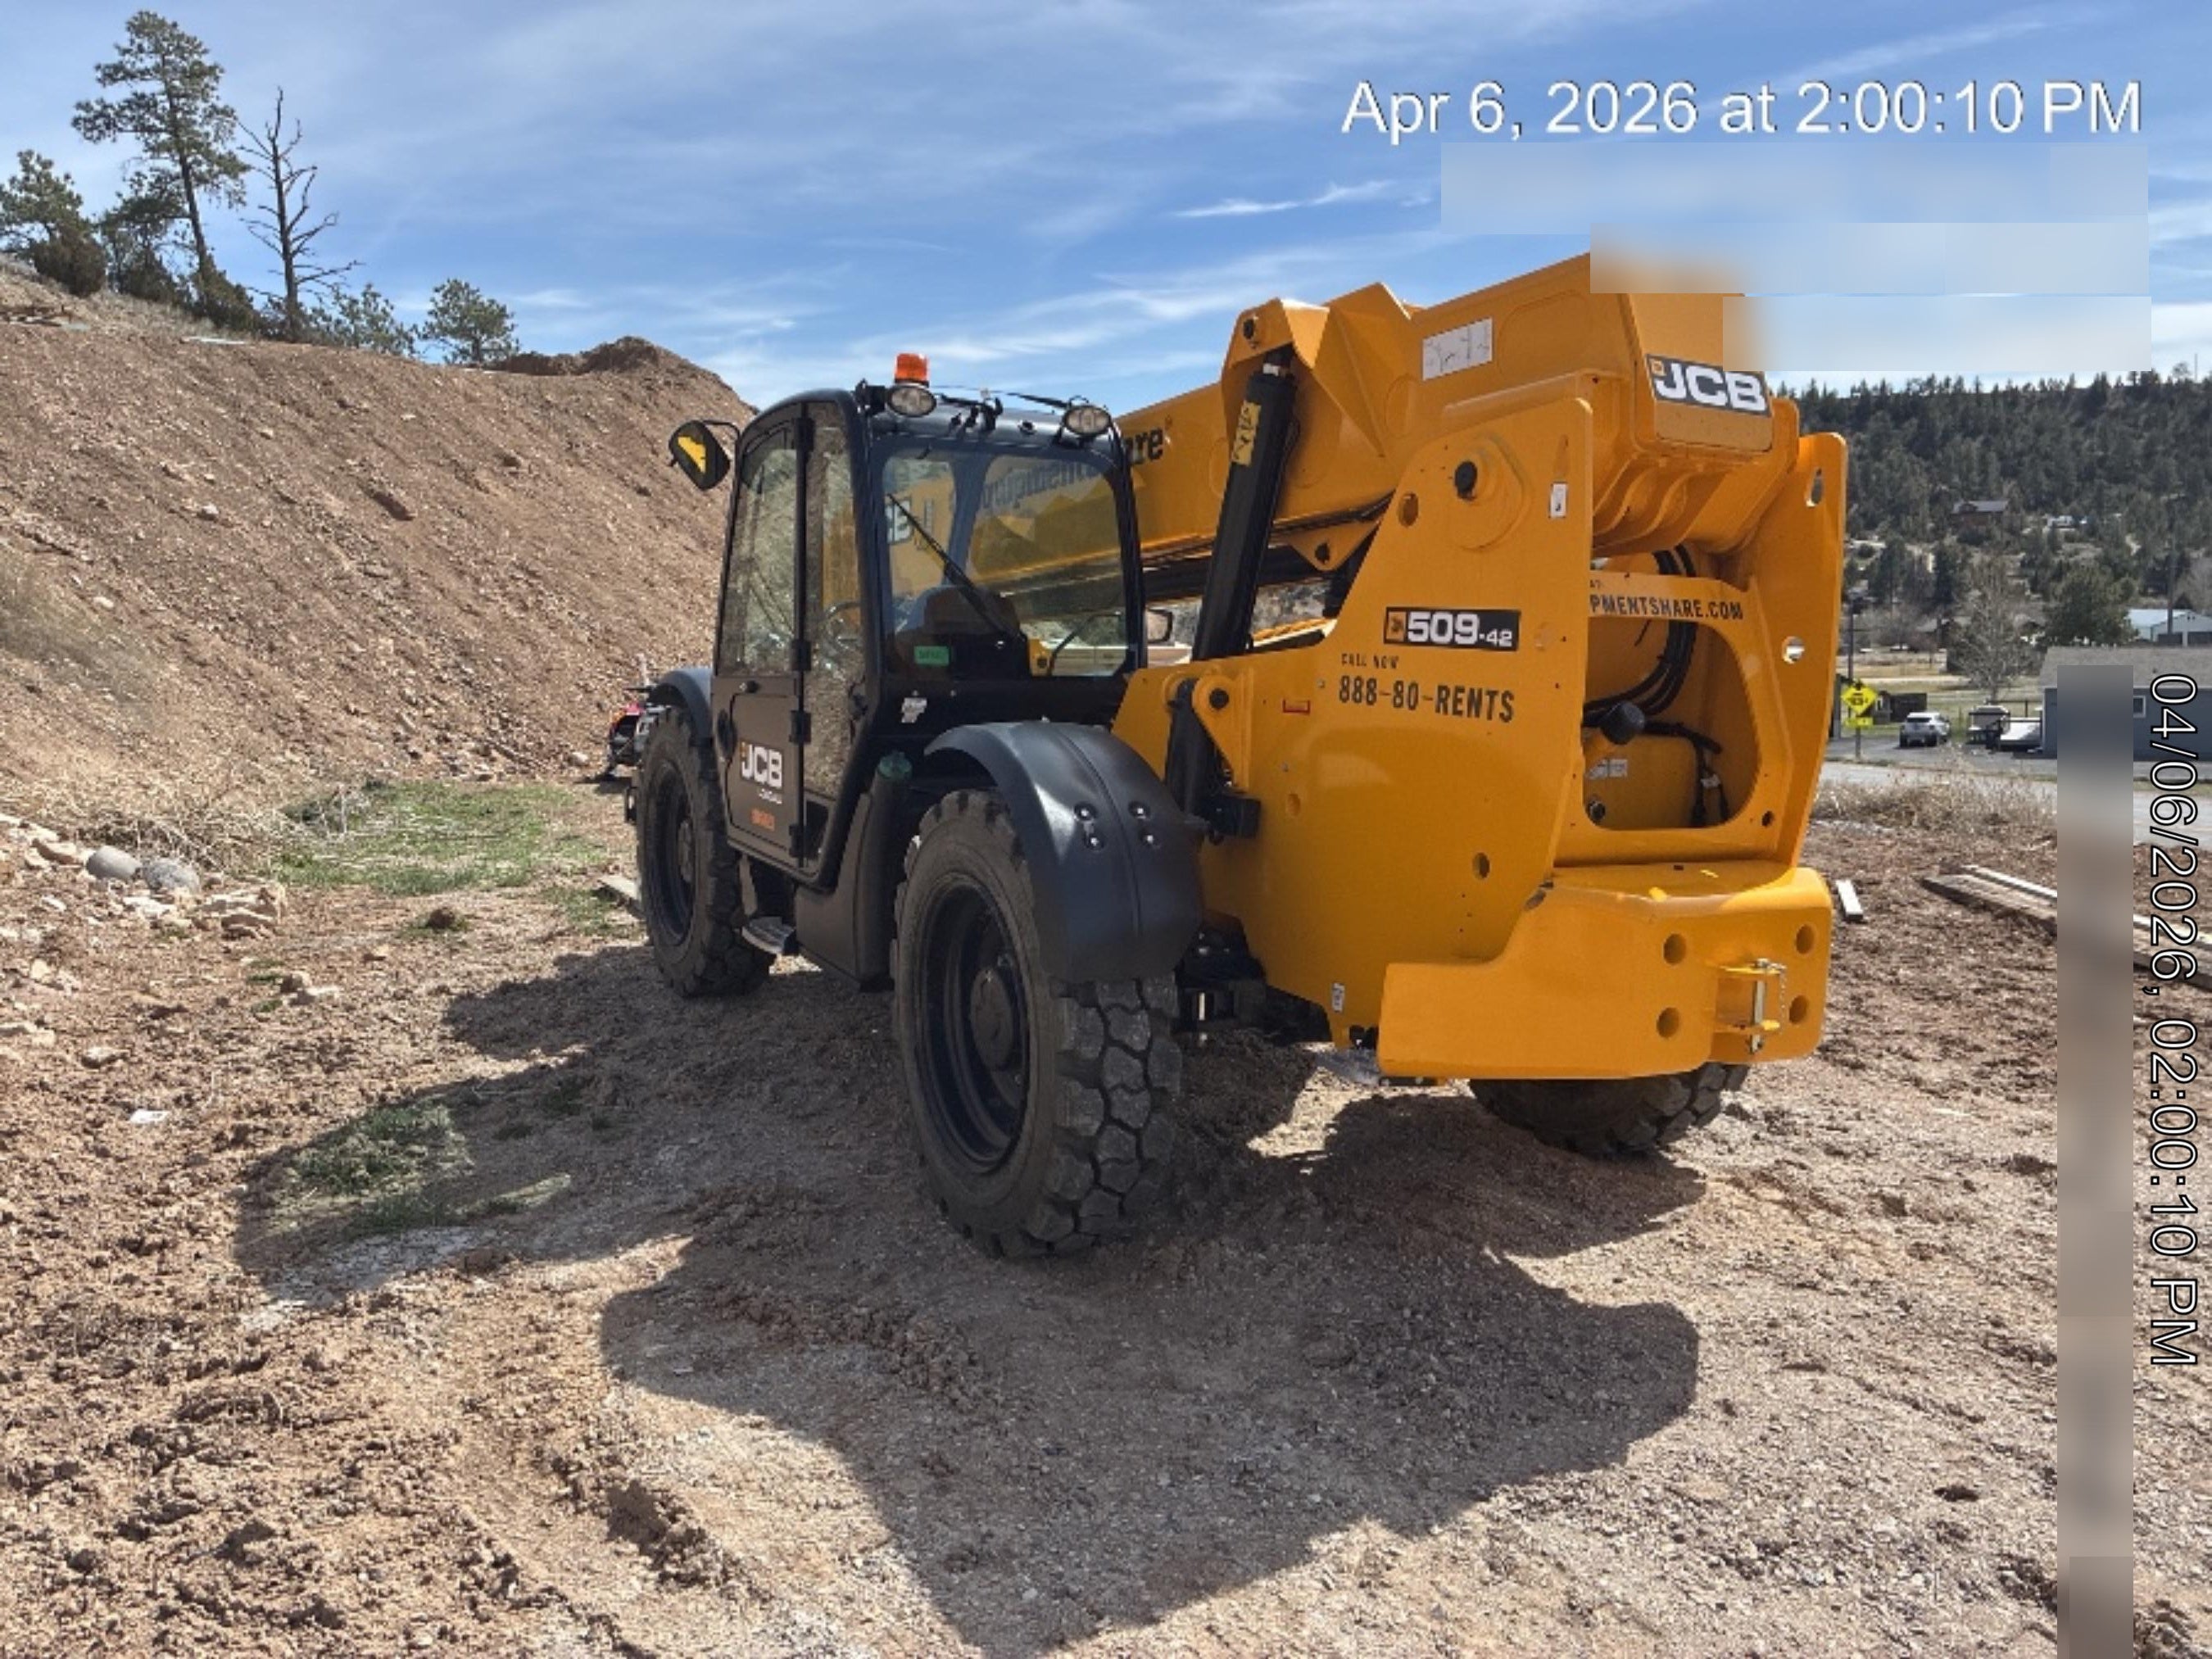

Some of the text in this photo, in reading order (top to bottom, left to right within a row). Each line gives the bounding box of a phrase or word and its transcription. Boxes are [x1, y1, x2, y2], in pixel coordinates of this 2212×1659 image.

[1654, 362, 1766, 411] JCB
[1341, 653, 1399, 669] CALL NOW
[1339, 674, 1515, 723] 888-80-RENTS
[741, 742, 782, 789] JCB
